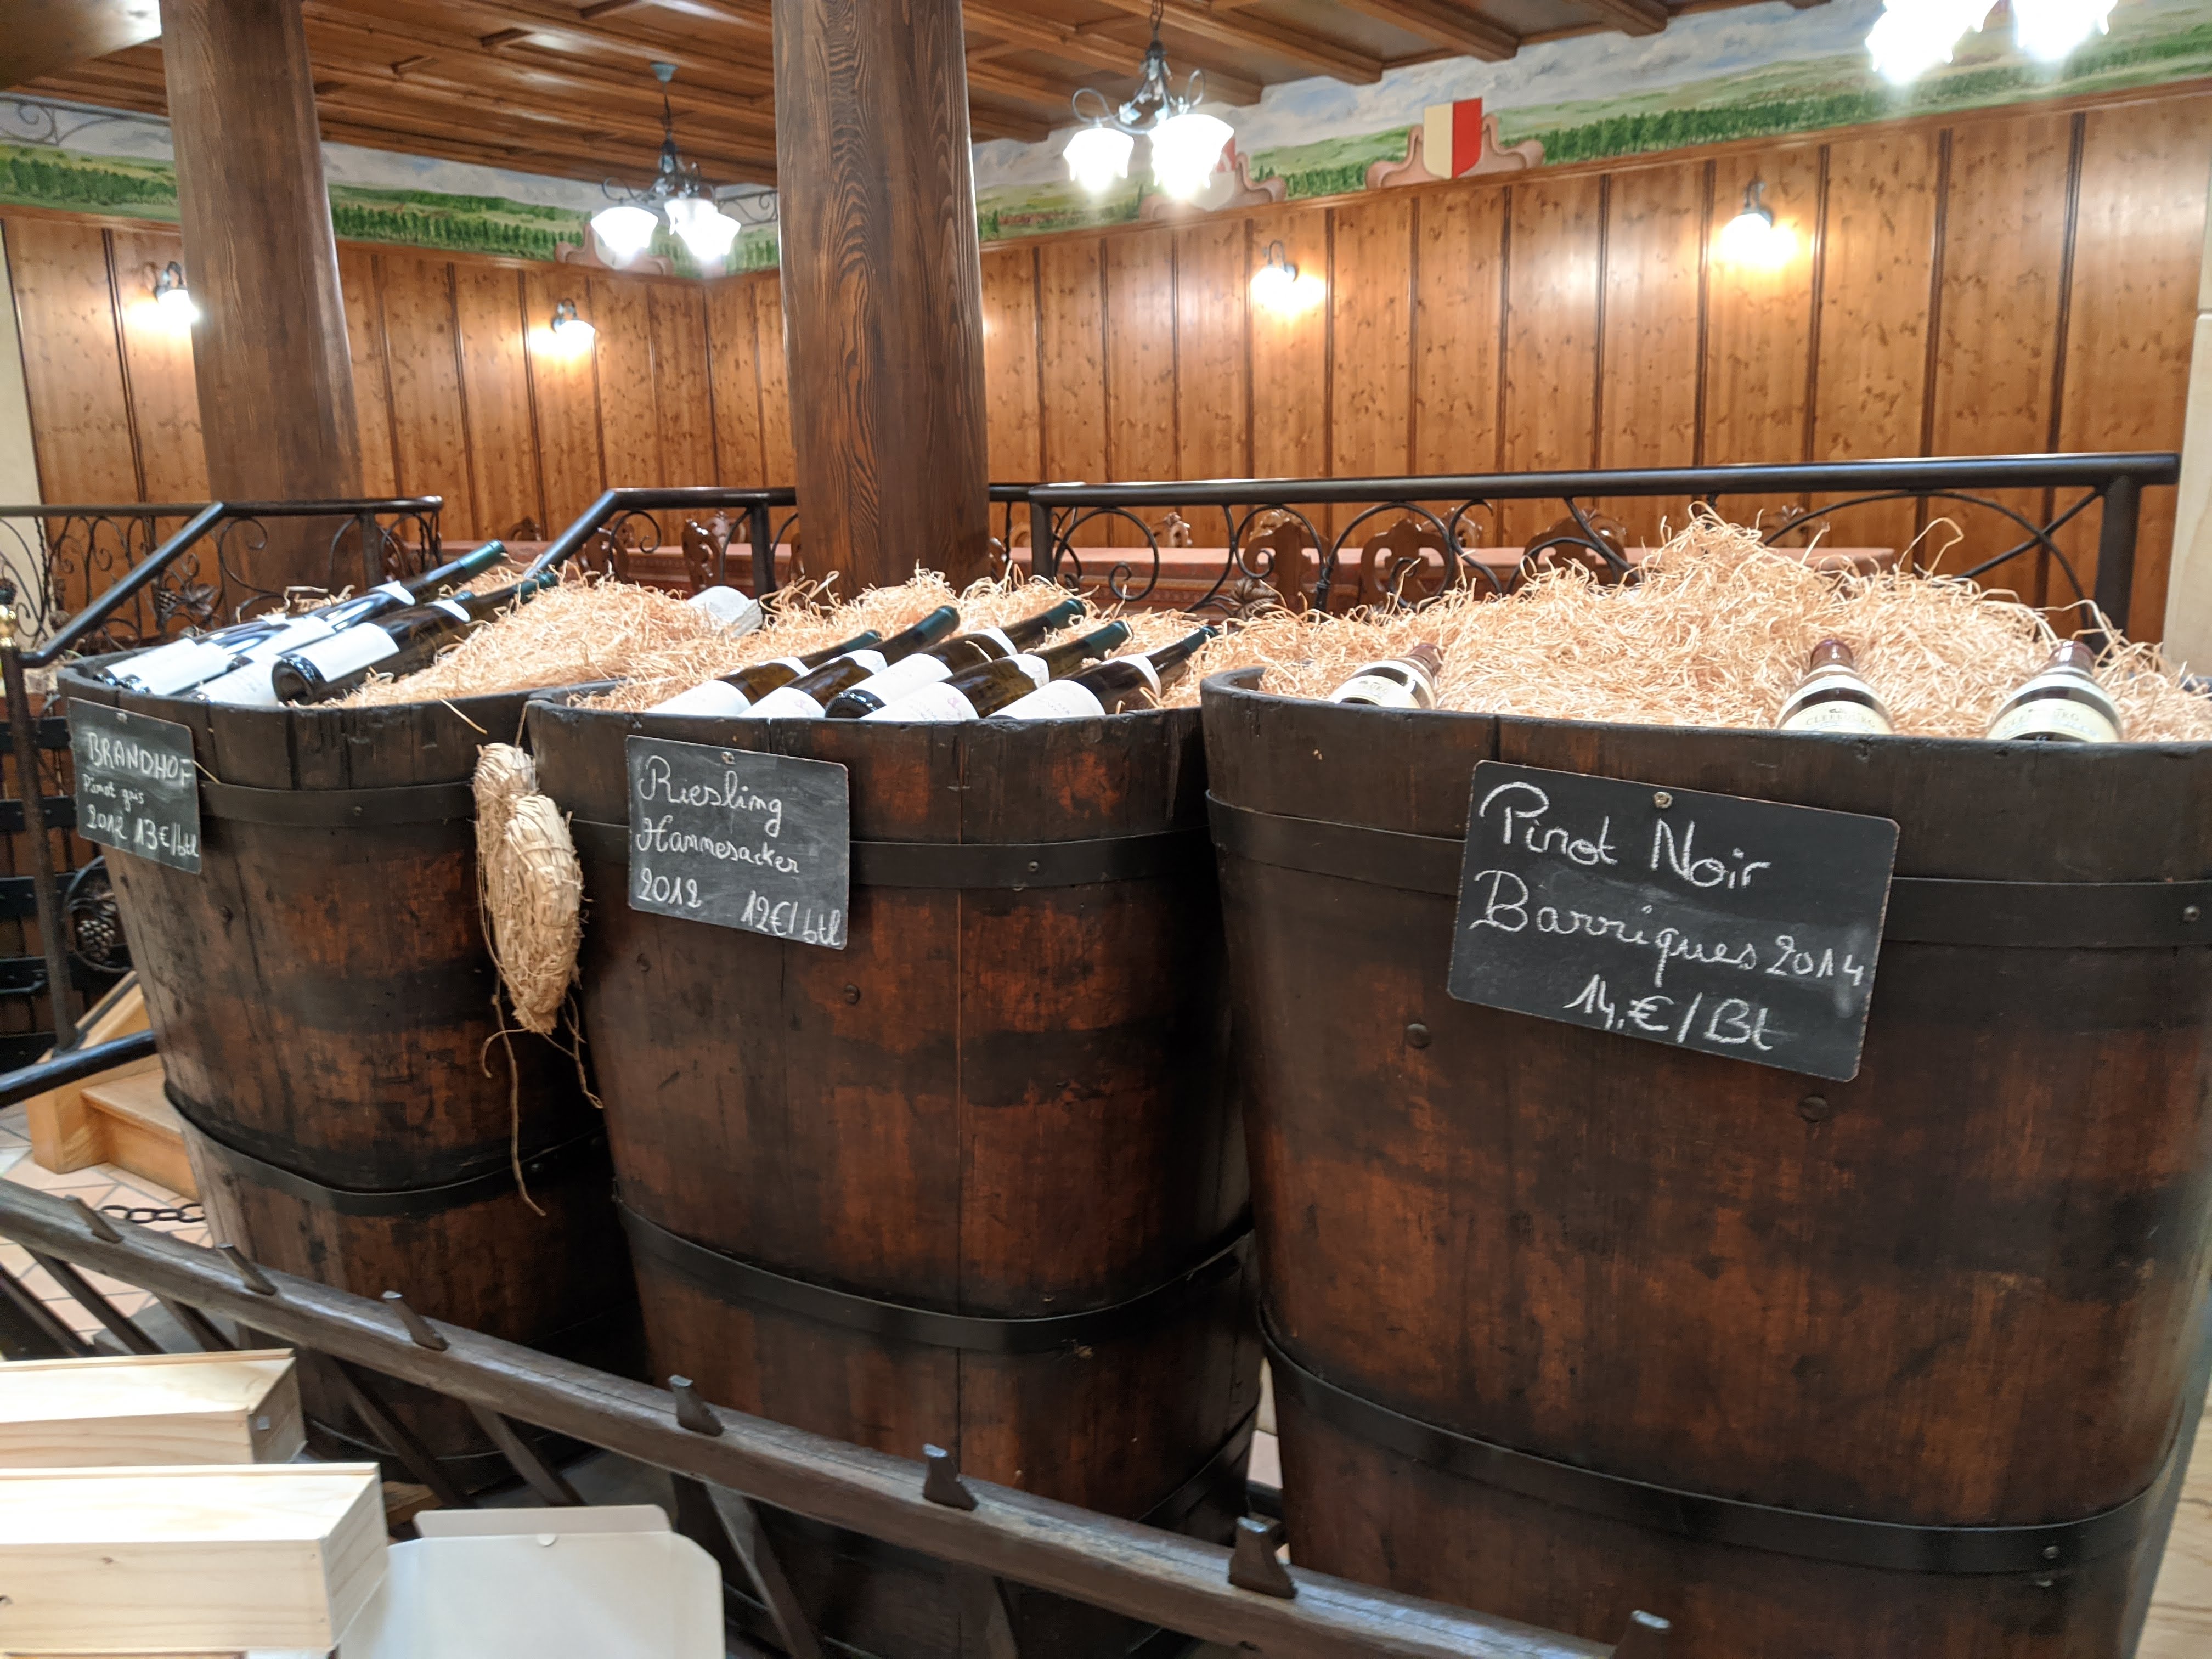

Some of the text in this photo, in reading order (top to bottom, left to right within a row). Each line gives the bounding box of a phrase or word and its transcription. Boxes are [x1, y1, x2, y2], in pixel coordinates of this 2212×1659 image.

[82, 773, 117, 799] Pinot
[87, 732, 192, 787] BRANDHOF
[86, 803, 128, 839] 2012
[637, 755, 782, 838] Riesling
[1479, 781, 1772, 889] Pinot Noir
[636, 867, 702, 909] 2012
[1468, 869, 1865, 988] Barriques 2014
